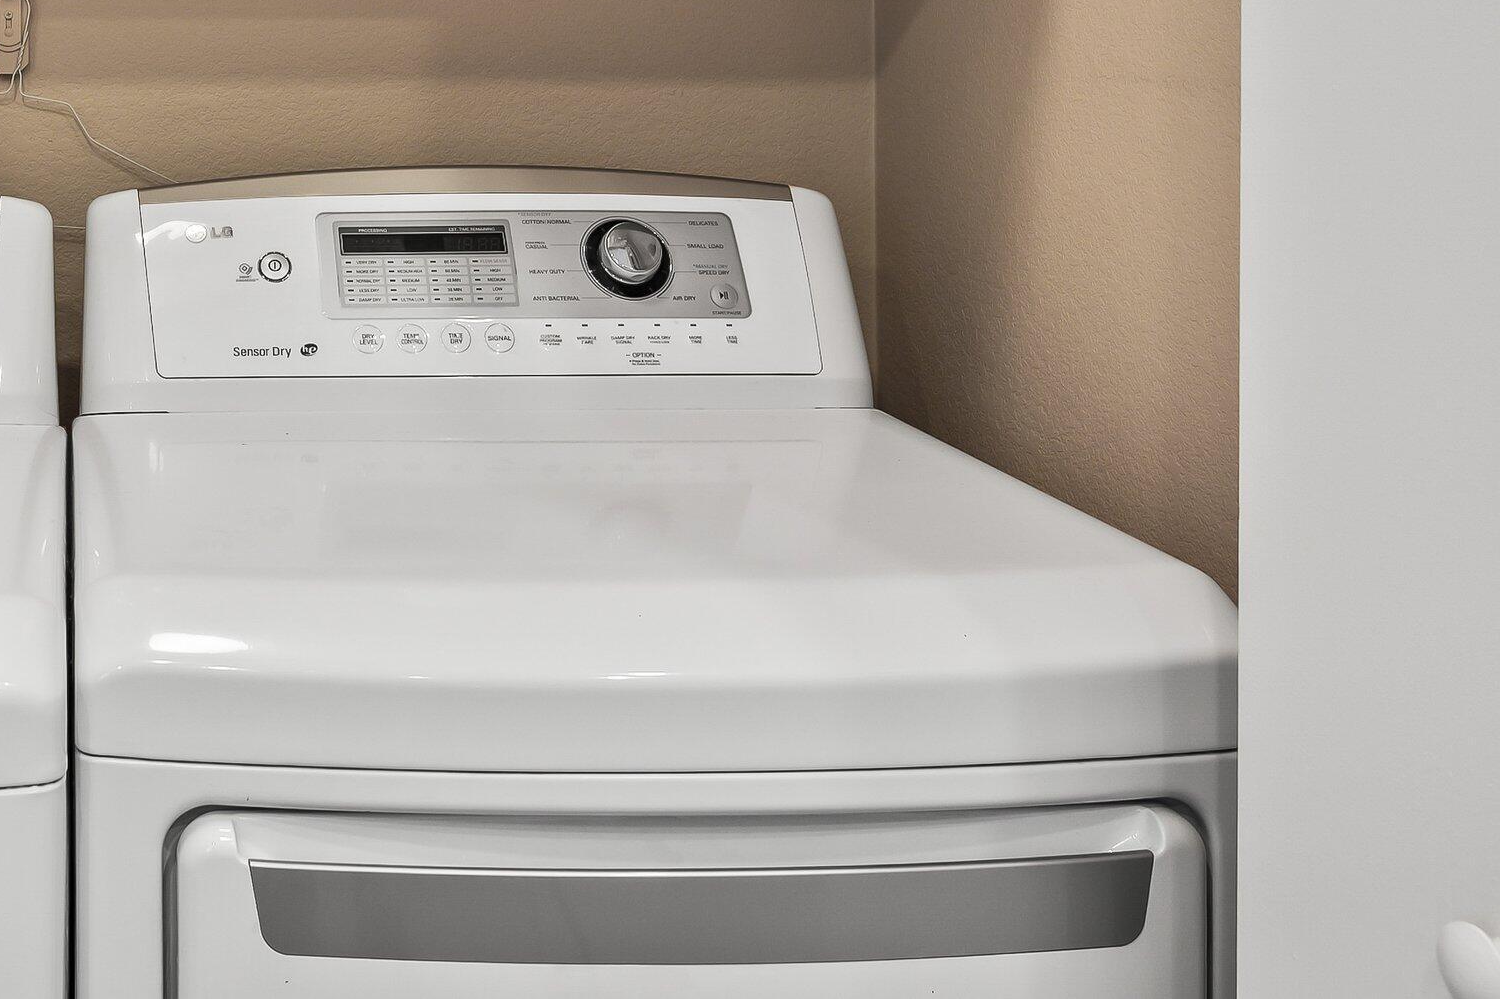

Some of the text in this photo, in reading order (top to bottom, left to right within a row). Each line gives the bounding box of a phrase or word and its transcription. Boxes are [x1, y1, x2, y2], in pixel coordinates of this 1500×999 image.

[210, 226, 234, 239] LG
[233, 346, 292, 358] Sensor Dry
